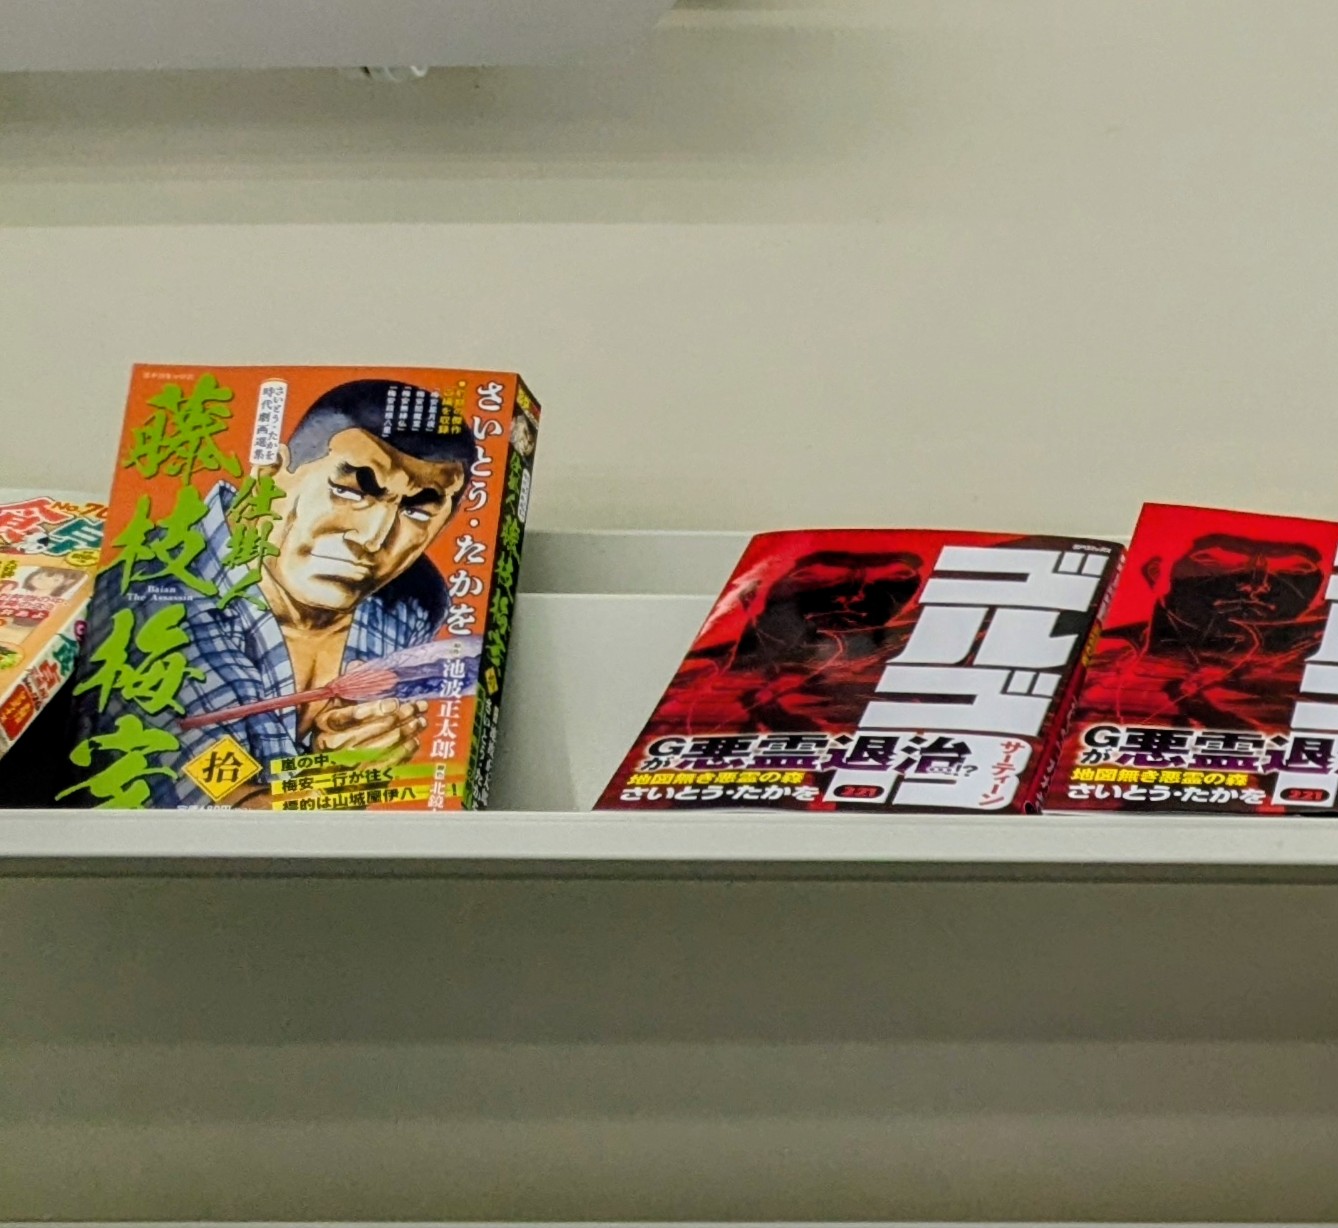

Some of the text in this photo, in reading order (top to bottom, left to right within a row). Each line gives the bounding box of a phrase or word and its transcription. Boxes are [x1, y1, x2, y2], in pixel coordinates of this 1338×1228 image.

[225, 468, 286, 609] 仕掛人
[858, 545, 1107, 737] ゴルゴ
[429, 658, 466, 760] 池波正太郎
[202, 751, 243, 784] 拾
[281, 769, 394, 791] 梅安一行が往く
[978, 740, 1026, 807] サーティーン
